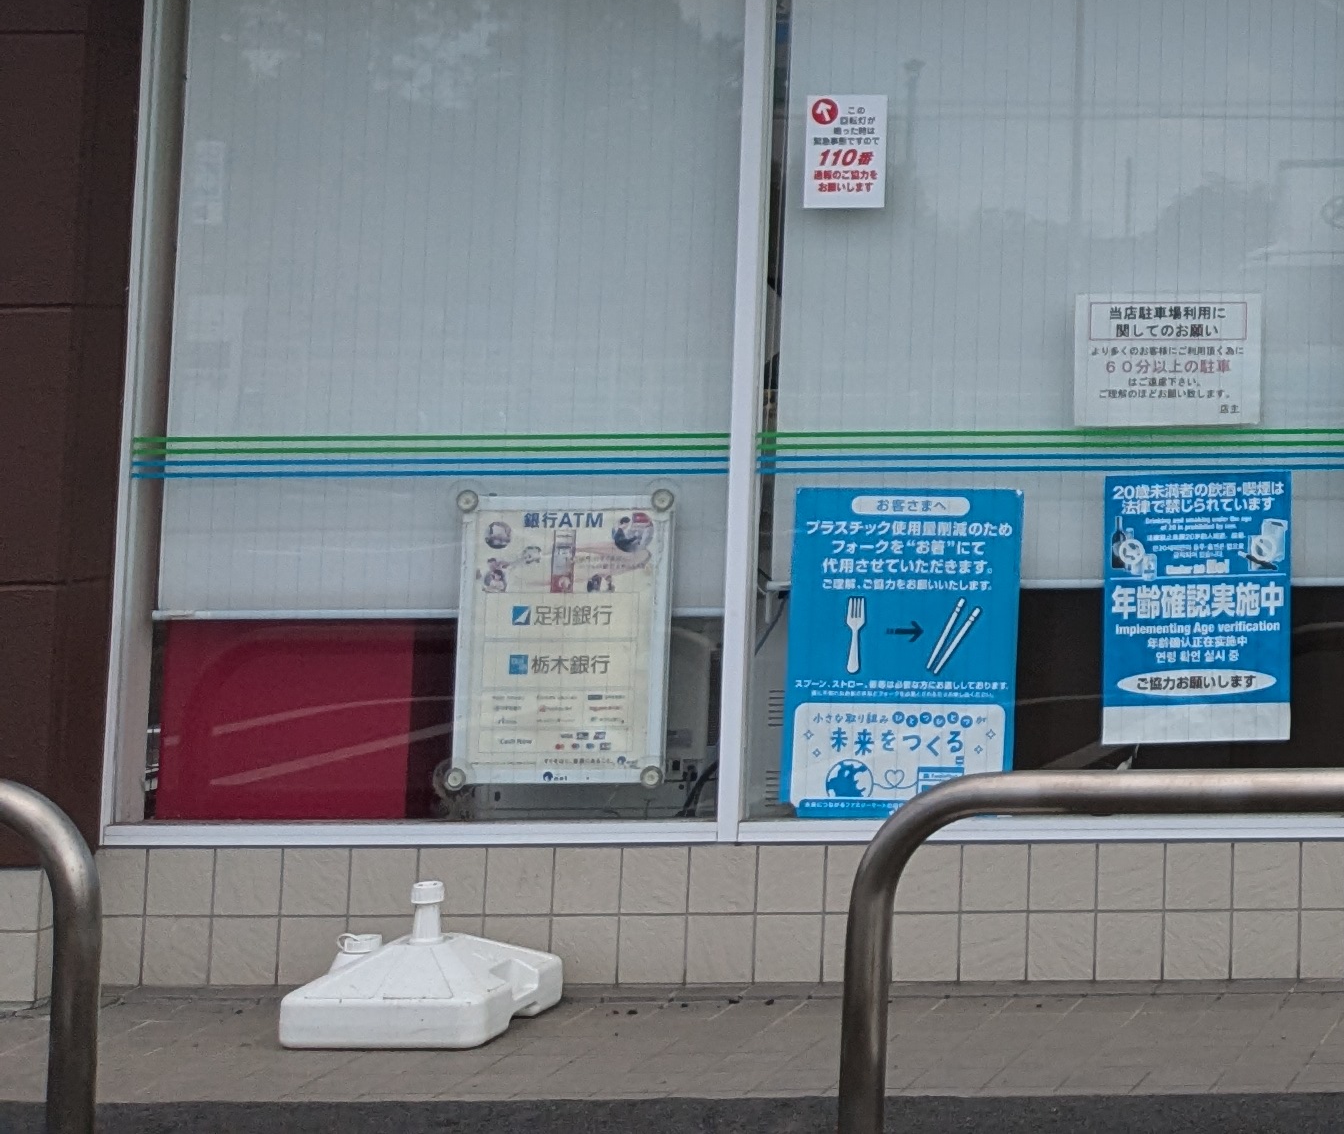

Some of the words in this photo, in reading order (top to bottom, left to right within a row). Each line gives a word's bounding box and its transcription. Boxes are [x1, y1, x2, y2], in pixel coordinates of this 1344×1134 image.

[819, 148, 874, 166] 110番
[1109, 306, 1227, 320] 当店駐車場利用に
[1116, 323, 1219, 338] 関してのお願い
[876, 499, 947, 512] お客さまへ
[1121, 497, 1276, 515] 法律で禁じられています
[523, 512, 604, 528] 銀行ATM
[806, 520, 1013, 537] プラスチック使用量削減のため
[822, 558, 993, 574] 代用させていただきます。
[1112, 582, 1285, 619] 年齢確認実施中
[534, 606, 612, 626] 足利銀行
[1115, 623, 1191, 637] Implementing
[1193, 622, 1215, 635] Age
[1217, 620, 1280, 632] verification
[531, 655, 610, 675] 栃木銀行
[1136, 675, 1257, 691] ご協力お願いします
[830, 727, 964, 757] 未来をつくる
